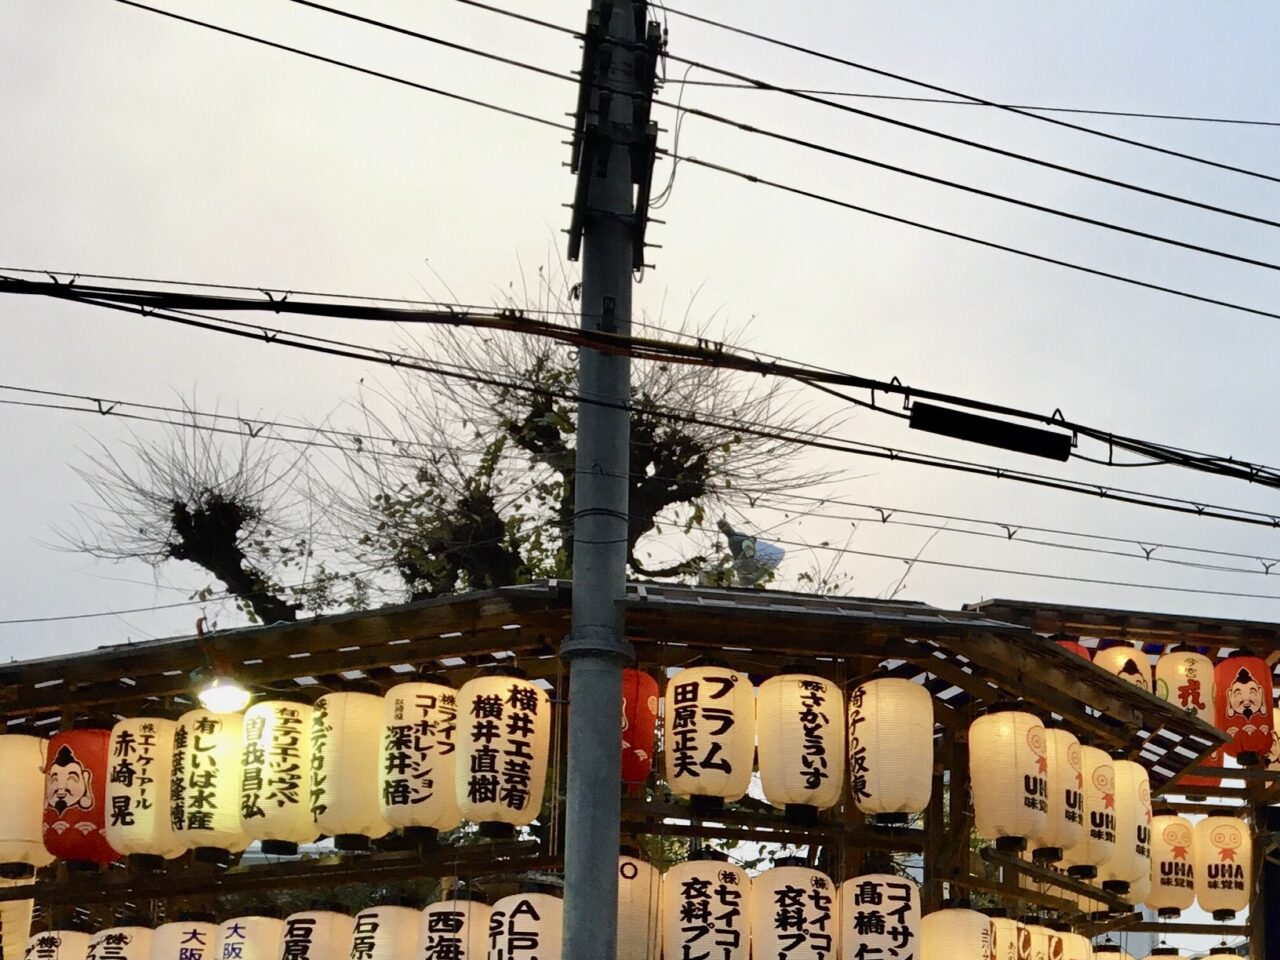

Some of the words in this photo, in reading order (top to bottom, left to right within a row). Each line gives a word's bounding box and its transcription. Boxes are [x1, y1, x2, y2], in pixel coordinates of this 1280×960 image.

[468, 694, 503, 804] 横井直樹
[672, 681, 700, 778] 田原正夫
[700, 675, 739, 775] プラム
[1207, 864, 1244, 879] UHA
